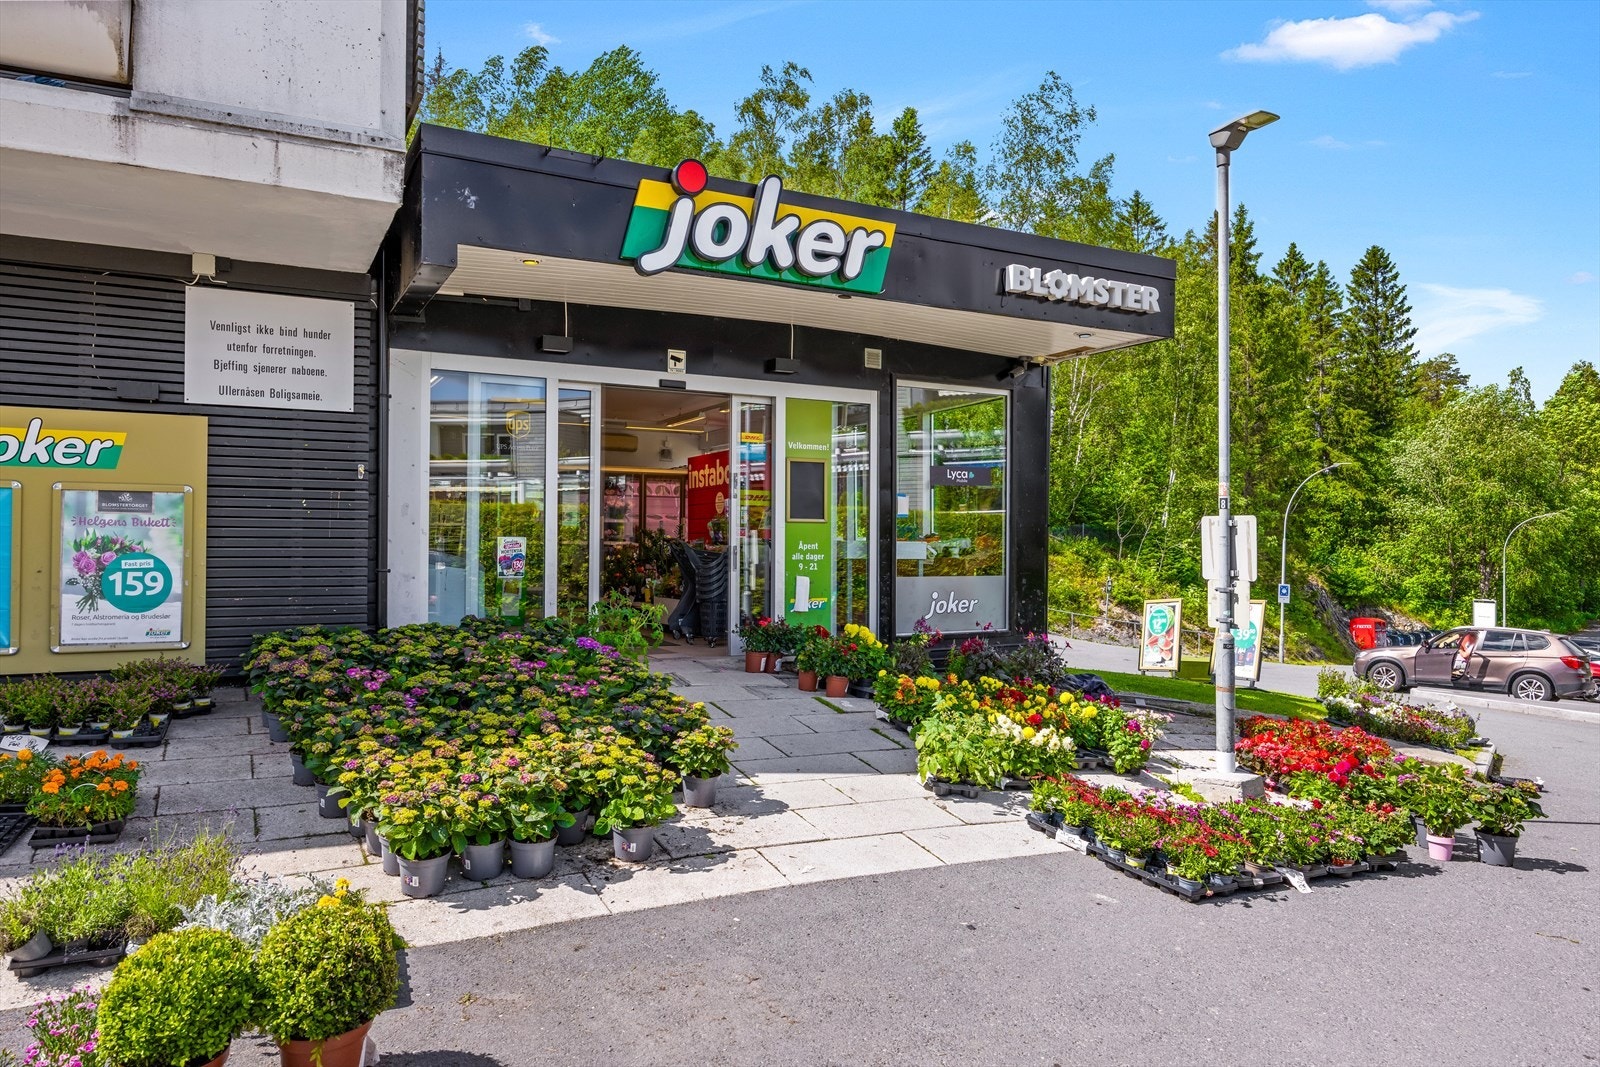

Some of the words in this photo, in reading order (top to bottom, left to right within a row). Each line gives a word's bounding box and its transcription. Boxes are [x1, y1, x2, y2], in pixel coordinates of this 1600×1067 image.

[634, 158, 886, 277] joker
[1005, 263, 1161, 313] BLOMSTER
[210, 320, 251, 335] Vennligst
[256, 324, 274, 335] ikke
[279, 326, 298, 337] bind
[303, 328, 331, 340] hunder
[227, 342, 258, 353] utenfor
[262, 344, 316, 359] forretningen.
[213, 359, 248, 374] Bjeffing
[253, 363, 287, 375] sjenerer
[291, 365, 328, 377] naboene.
[218, 385, 265, 398] Ullernåsen
[269, 388, 323, 401] Boligsameie.
[508, 417, 529, 435] ups
[0, 417, 114, 466] oker
[788, 441, 830, 451] Velkommen!
[946, 469, 968, 480] Lyca
[1220, 499, 1226, 509] 8
[78, 516, 127, 528] Helgens
[131, 517, 171, 528] Bukett
[798, 540, 818, 552] Åpent
[805, 553, 825, 561] dager
[798, 563, 803, 571] 9
[809, 563, 818, 571] 21
[108, 571, 164, 596] 159
[924, 591, 979, 620] joker
[72, 614, 92, 622] Roser,
